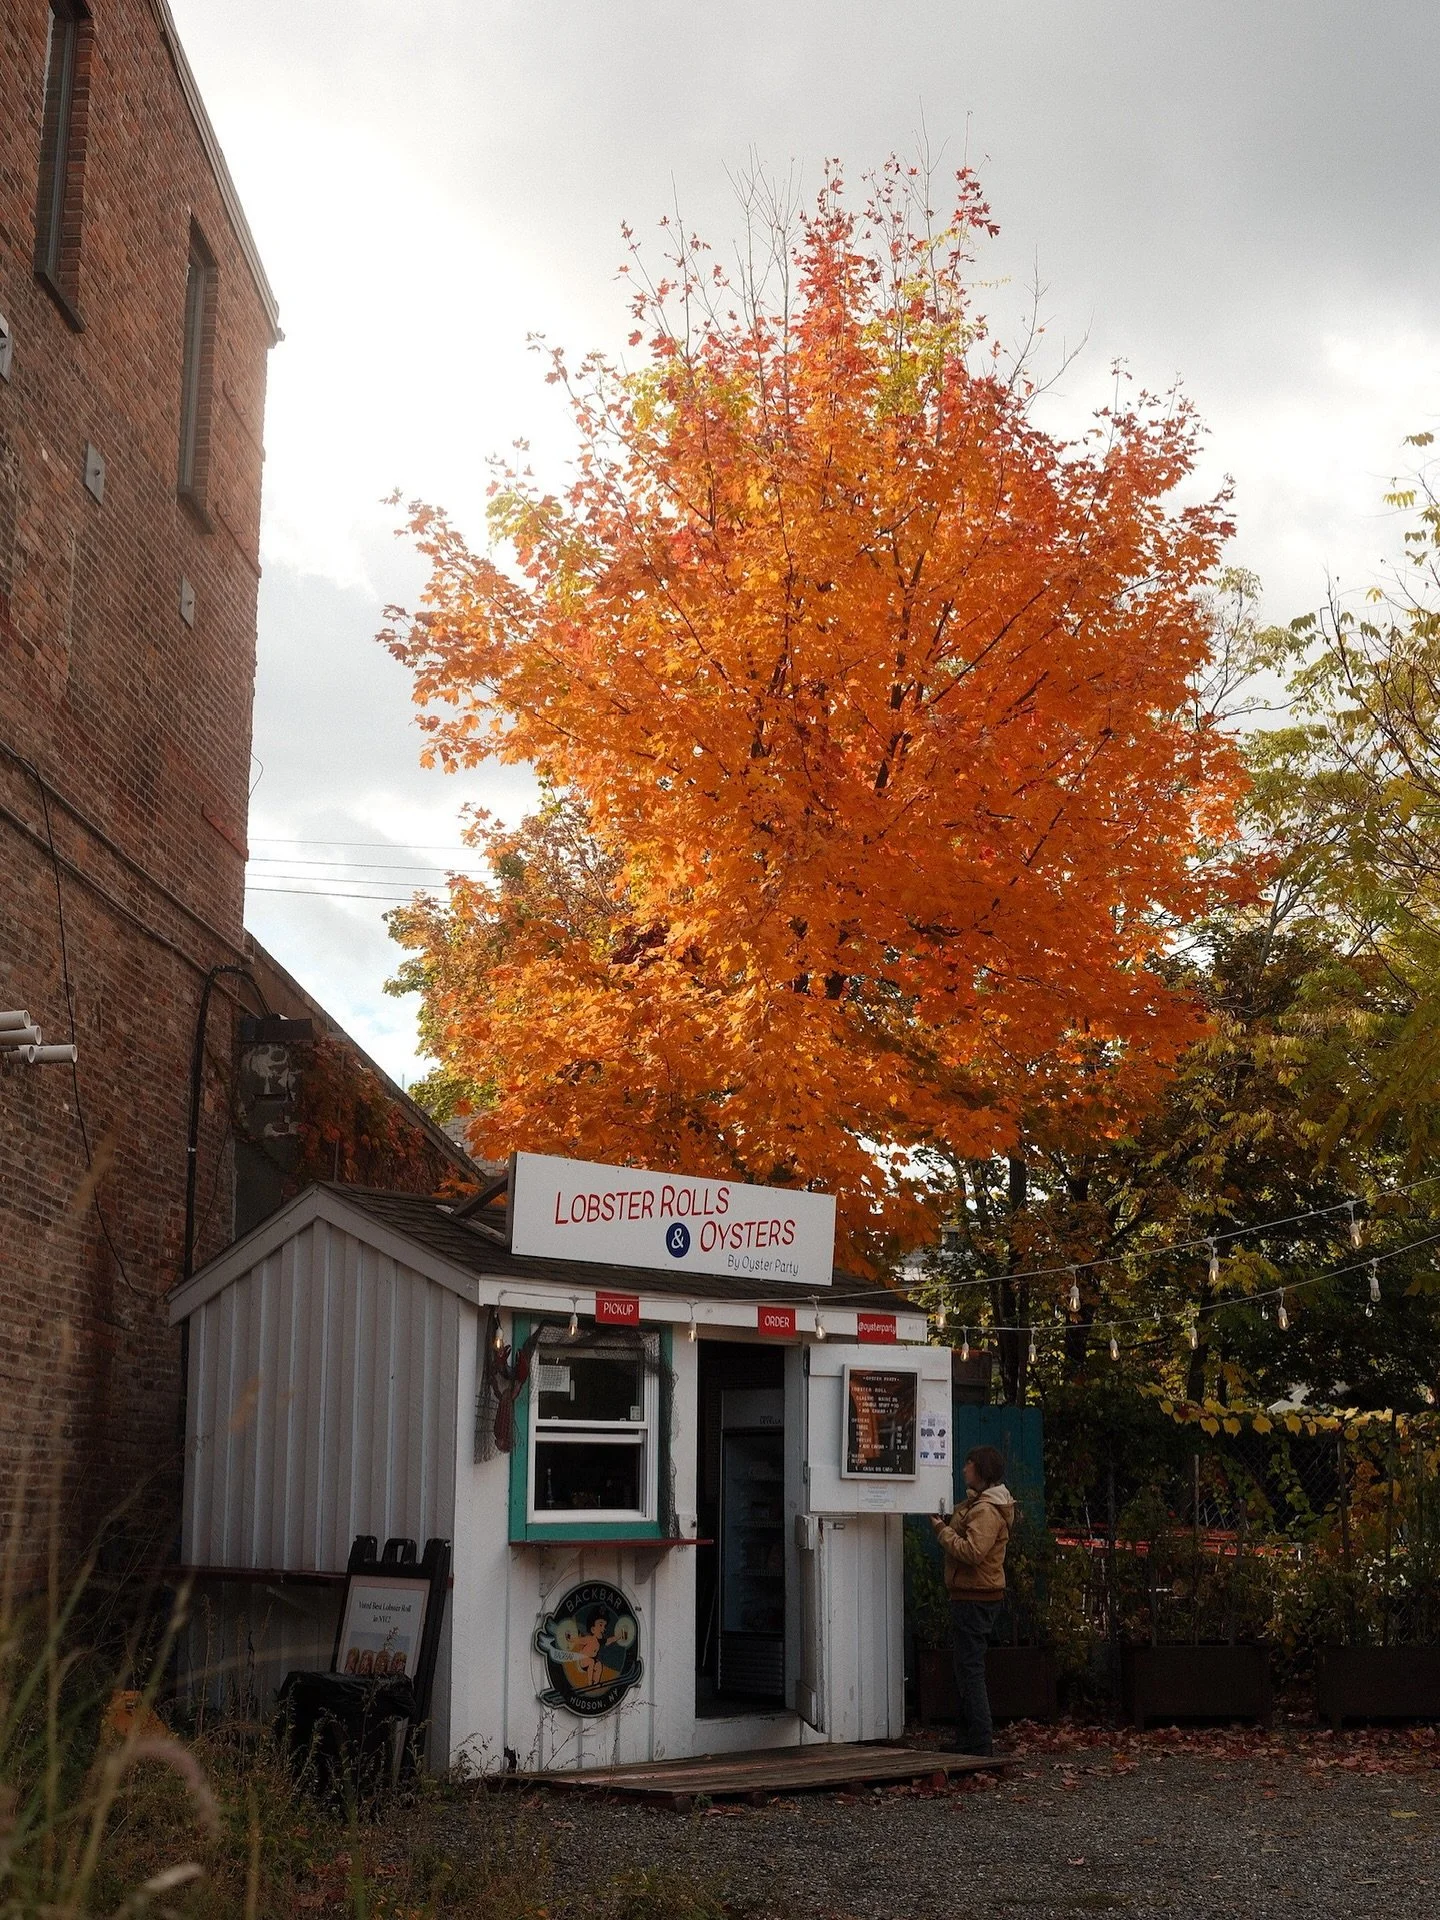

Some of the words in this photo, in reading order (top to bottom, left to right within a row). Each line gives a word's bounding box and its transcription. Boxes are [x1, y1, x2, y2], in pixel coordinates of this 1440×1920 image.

[555, 1190, 654, 1224] LOBSTER
[660, 1185, 730, 1218] ROLLS
[671, 1228, 684, 1249] &
[700, 1219, 796, 1252] OYSTERS
[728, 1254, 740, 1271] By
[742, 1255, 773, 1272] Oyster
[774, 1258, 799, 1276] Party
[603, 1302, 634, 1316] PICKUP
[764, 1314, 790, 1328] ORDER
[858, 1321, 896, 1335] @oysterparty
[565, 1588, 622, 1613] BACKBAR
[608, 1688, 620, 1703] NY
